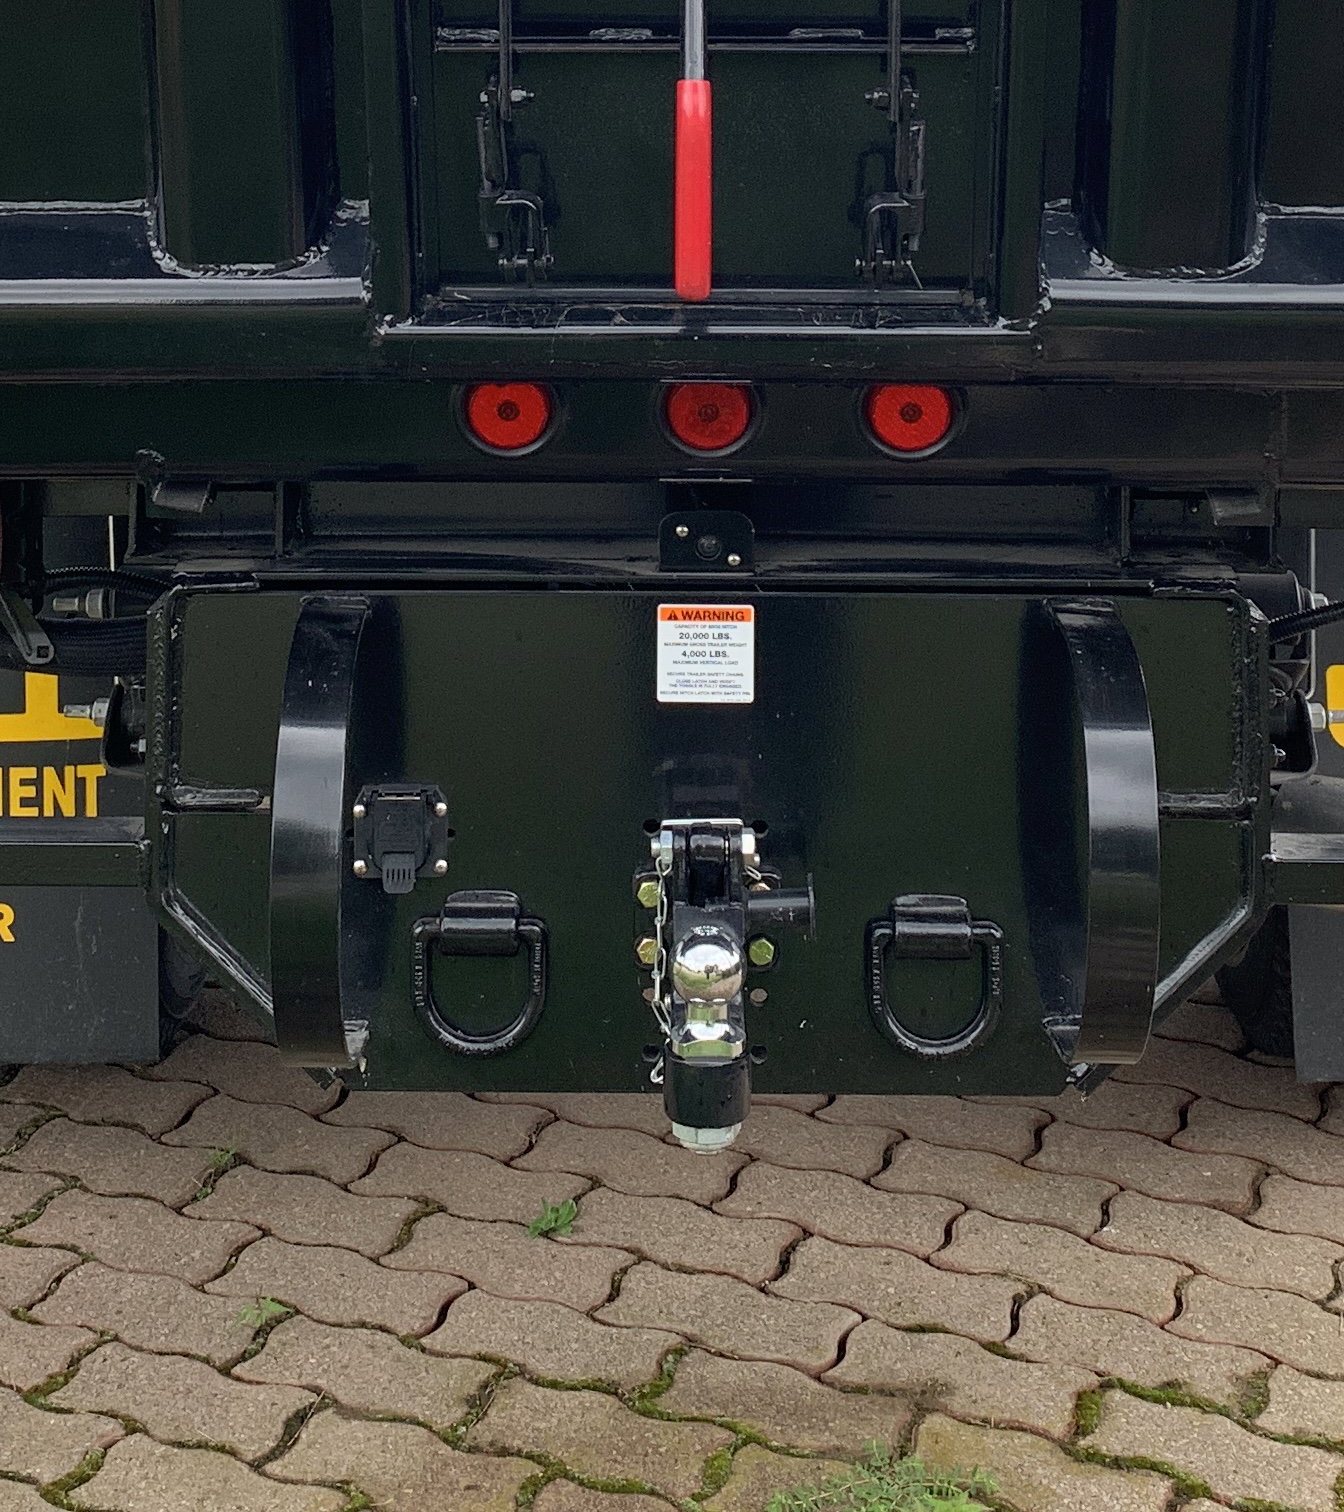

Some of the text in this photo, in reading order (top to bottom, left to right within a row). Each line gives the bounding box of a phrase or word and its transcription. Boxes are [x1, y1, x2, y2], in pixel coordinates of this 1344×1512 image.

[681, 610, 745, 622] WARNING
[679, 632, 732, 641] 20,000 LBS.
[681, 650, 707, 659] 4,000
